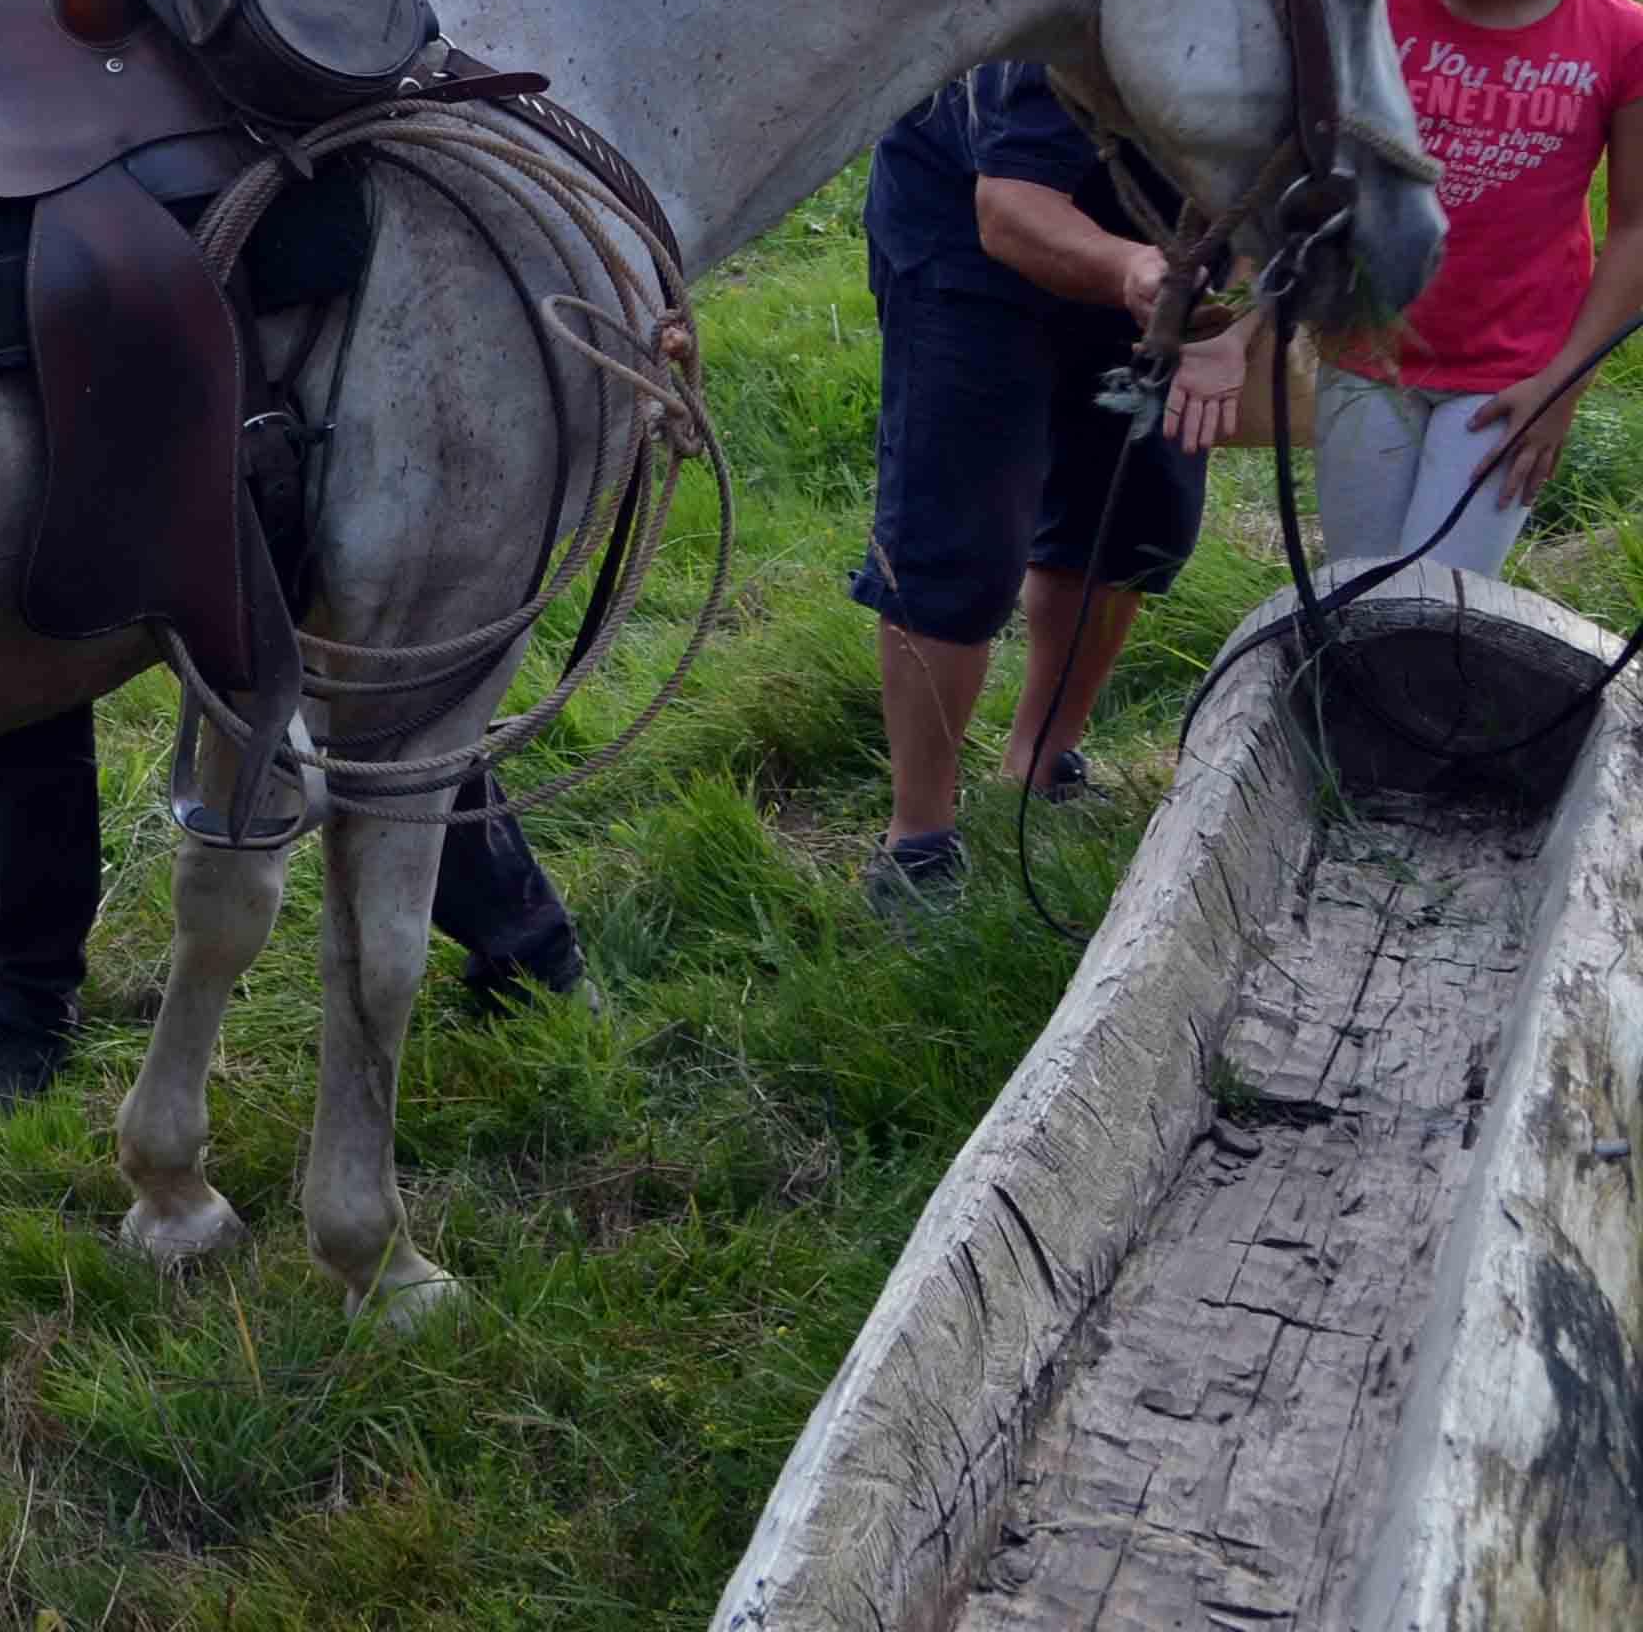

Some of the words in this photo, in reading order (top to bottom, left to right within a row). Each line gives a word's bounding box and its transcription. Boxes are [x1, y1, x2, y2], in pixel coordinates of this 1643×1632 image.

[1502, 51, 1599, 98] think
[1407, 74, 1585, 134] ENETTON
[1445, 136, 1544, 169] happen
[1498, 127, 1565, 154] things
